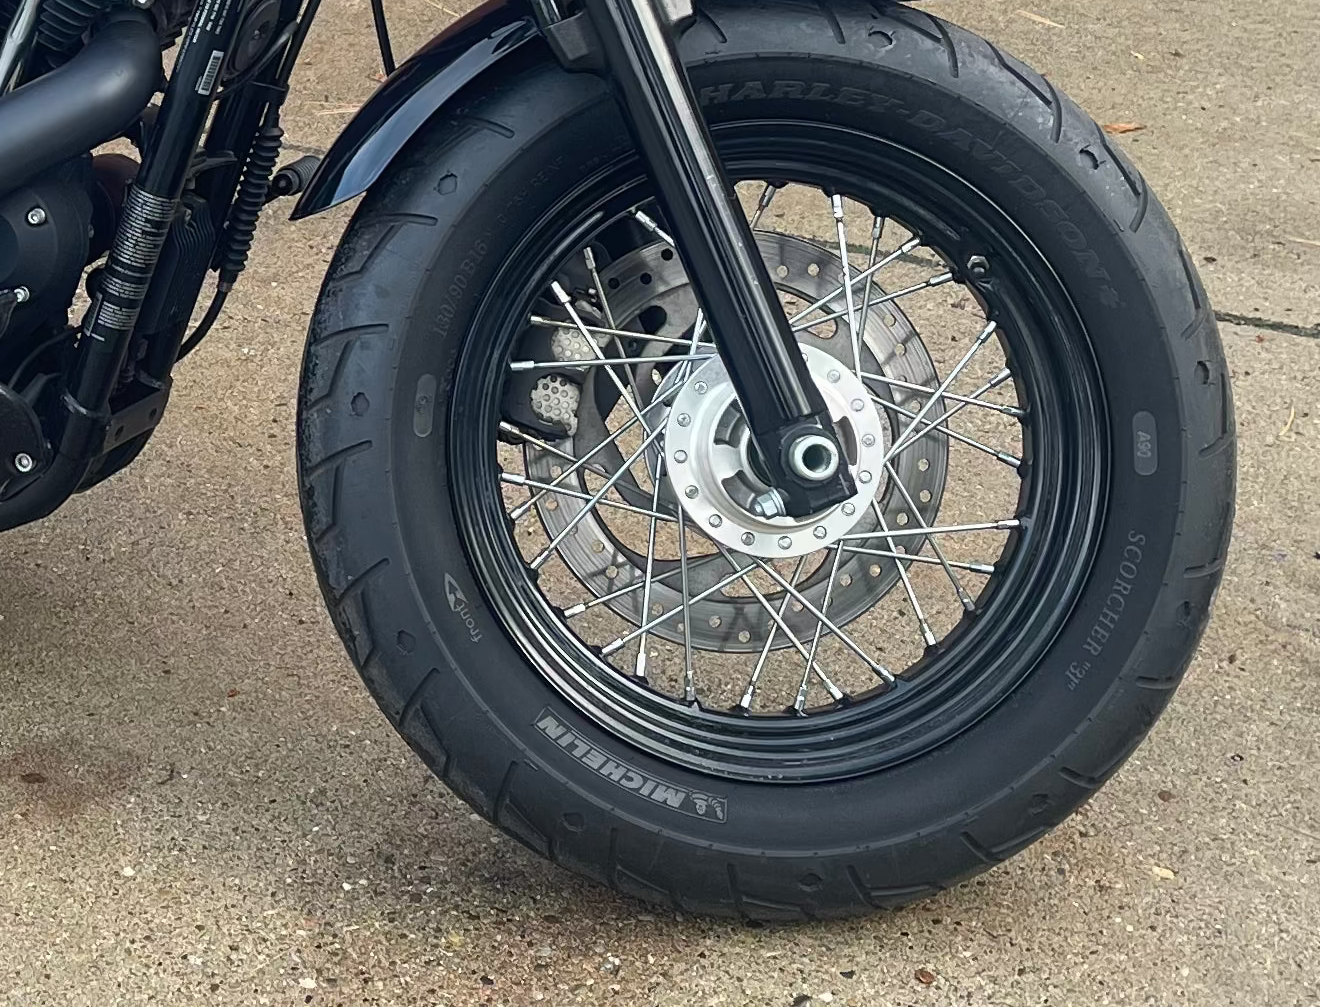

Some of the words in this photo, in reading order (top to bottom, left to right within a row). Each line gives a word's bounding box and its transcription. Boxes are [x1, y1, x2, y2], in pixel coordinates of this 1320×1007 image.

[700, 80, 1110, 285] HARLEY-DAVIDSON
[455, 605, 482, 644] front
[1083, 530, 1146, 657] SCORCHER
[537, 715, 687, 807] MICHELIN
